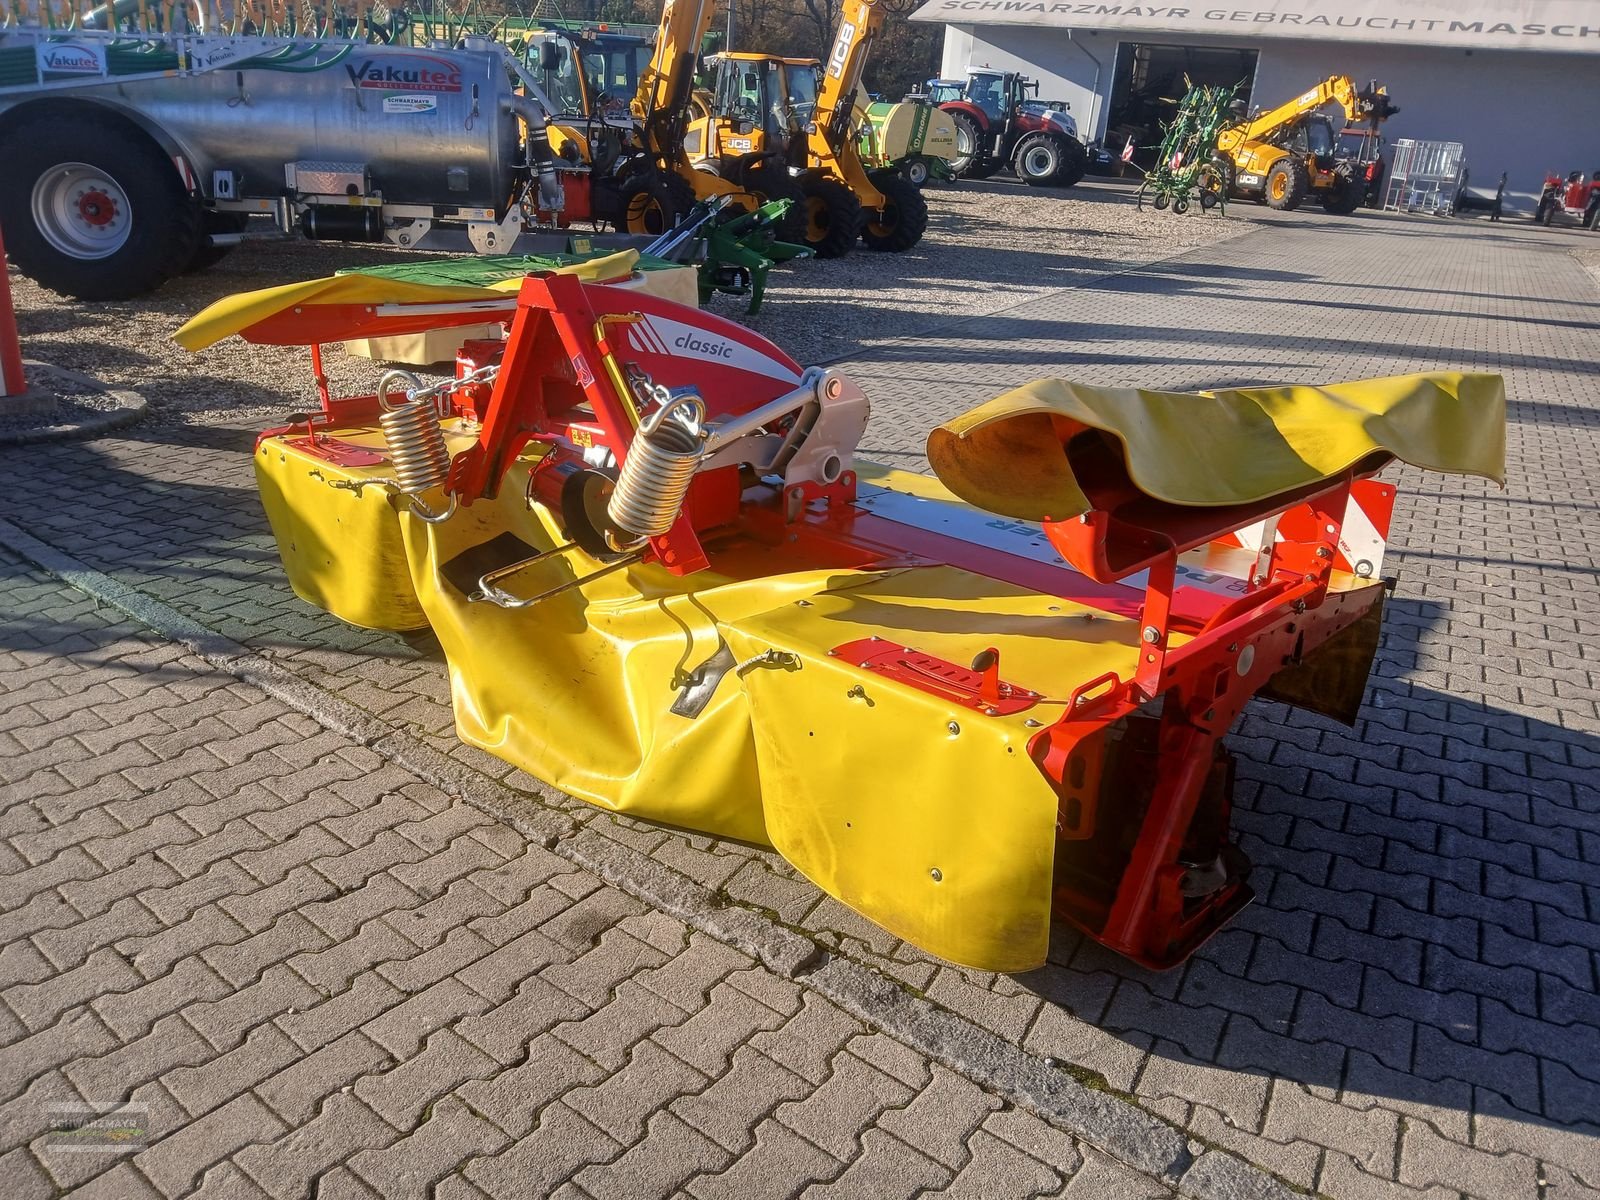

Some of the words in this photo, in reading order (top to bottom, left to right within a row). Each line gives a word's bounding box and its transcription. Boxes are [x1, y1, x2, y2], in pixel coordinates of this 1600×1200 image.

[941, 1, 1191, 18] SCHWARZMAYR
[43, 52, 100, 68] Vakutec
[829, 22, 856, 79] JCB
[345, 60, 462, 88] Vakutec
[917, 107, 928, 139] KRONE
[727, 138, 751, 149] JCB
[1240, 174, 1258, 184] JCB
[674, 333, 733, 358] classic
